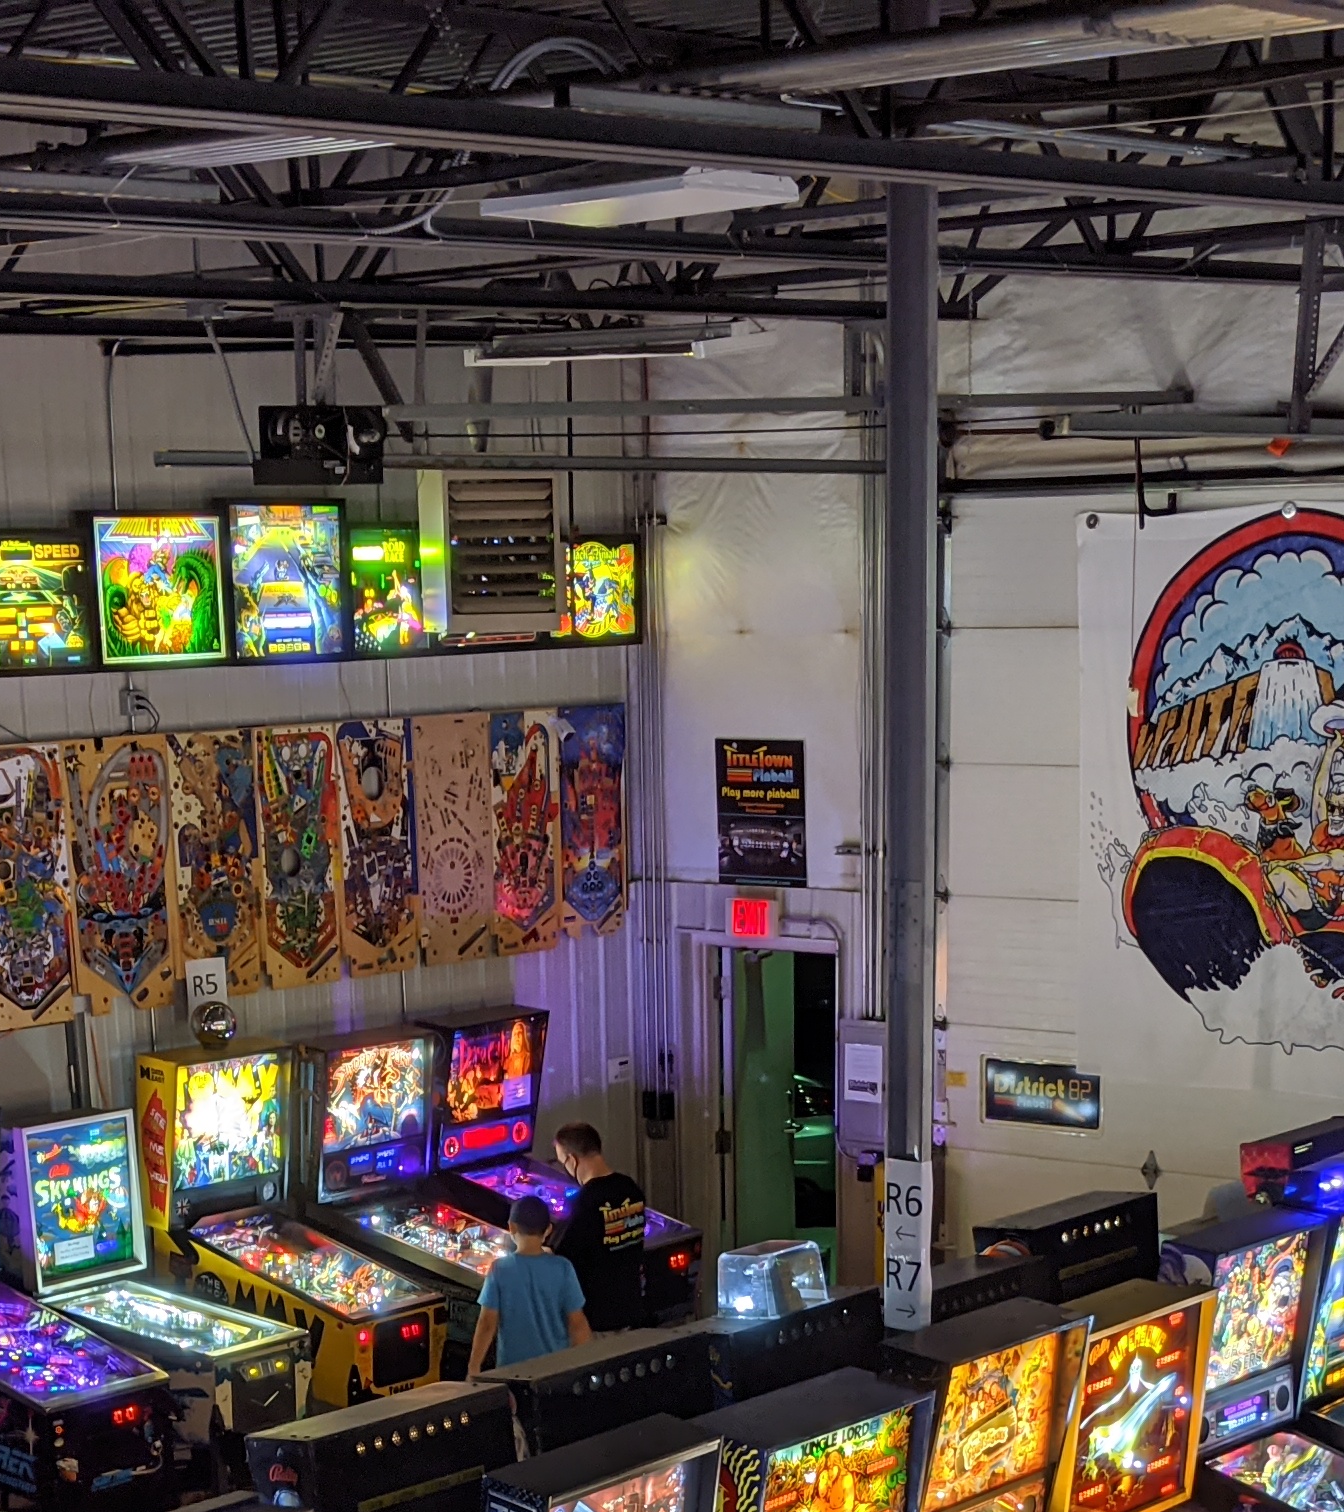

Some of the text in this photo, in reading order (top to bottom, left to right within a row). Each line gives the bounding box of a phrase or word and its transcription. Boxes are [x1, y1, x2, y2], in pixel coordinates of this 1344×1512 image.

[35, 544, 80, 558] SPEED
[753, 768, 794, 783] Pinball
[721, 786, 741, 800] Play
[743, 788, 765, 799] more
[733, 901, 767, 935] EXIT
[193, 974, 218, 997] R5
[993, 1073, 1092, 1101] District 82
[1016, 1095, 1054, 1109] Pinball
[72, 1166, 121, 1192] KINGS
[886, 1182, 923, 1217] R6
[200, 1274, 220, 1290] THE
[886, 1258, 922, 1292] R7
[1109, 1324, 1167, 1370] SUPERSONIC
[841, 1422, 870, 1444] LORD
[269, 1463, 298, 1485] Bally
